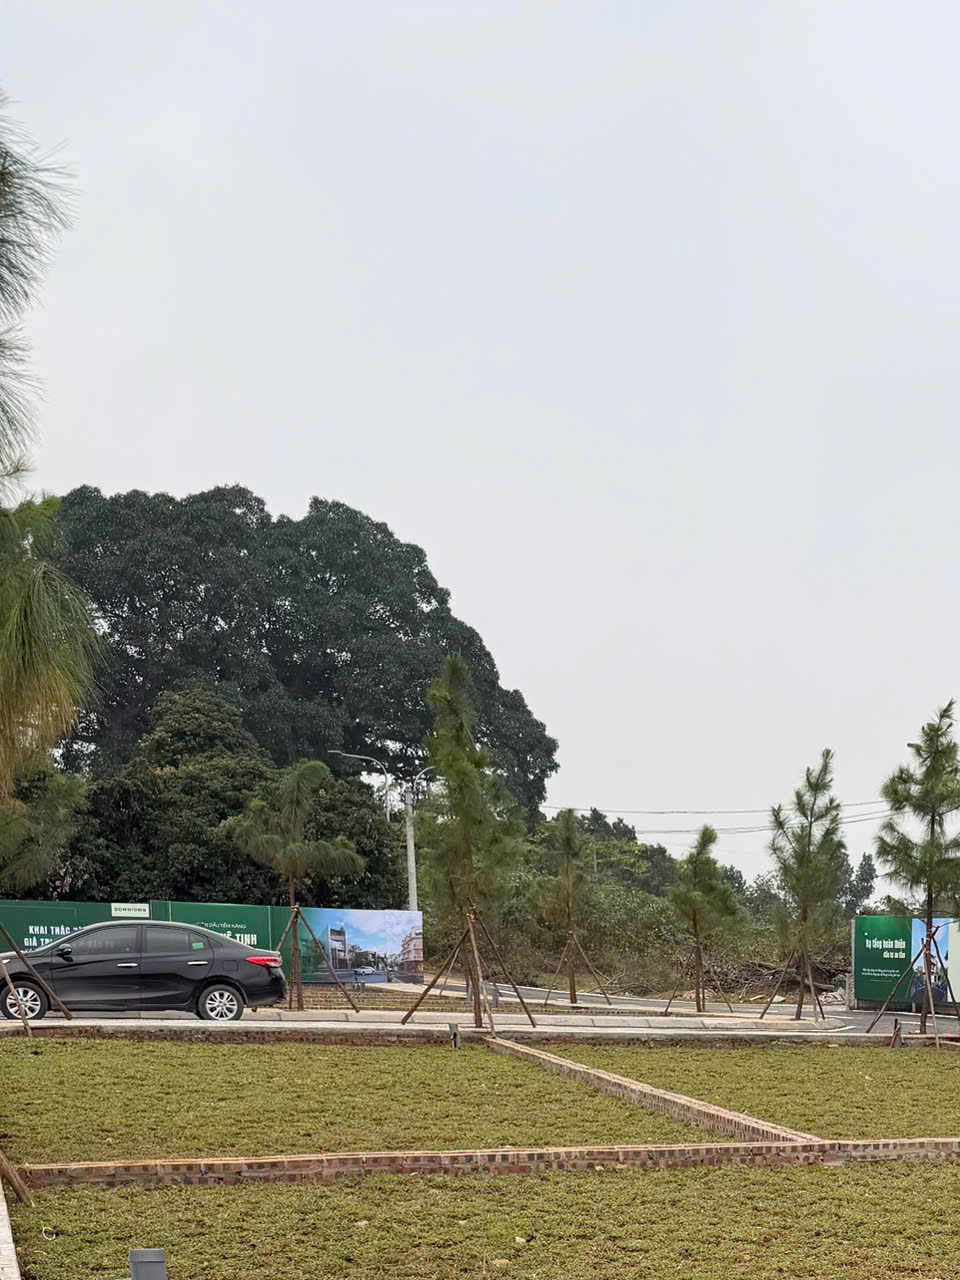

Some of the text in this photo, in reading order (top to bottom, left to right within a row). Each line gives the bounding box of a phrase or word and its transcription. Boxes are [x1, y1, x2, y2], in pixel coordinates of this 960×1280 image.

[29, 925, 48, 935] KHAI
[50, 924, 71, 936] THÁC
[23, 936, 38, 947] GIÁ
